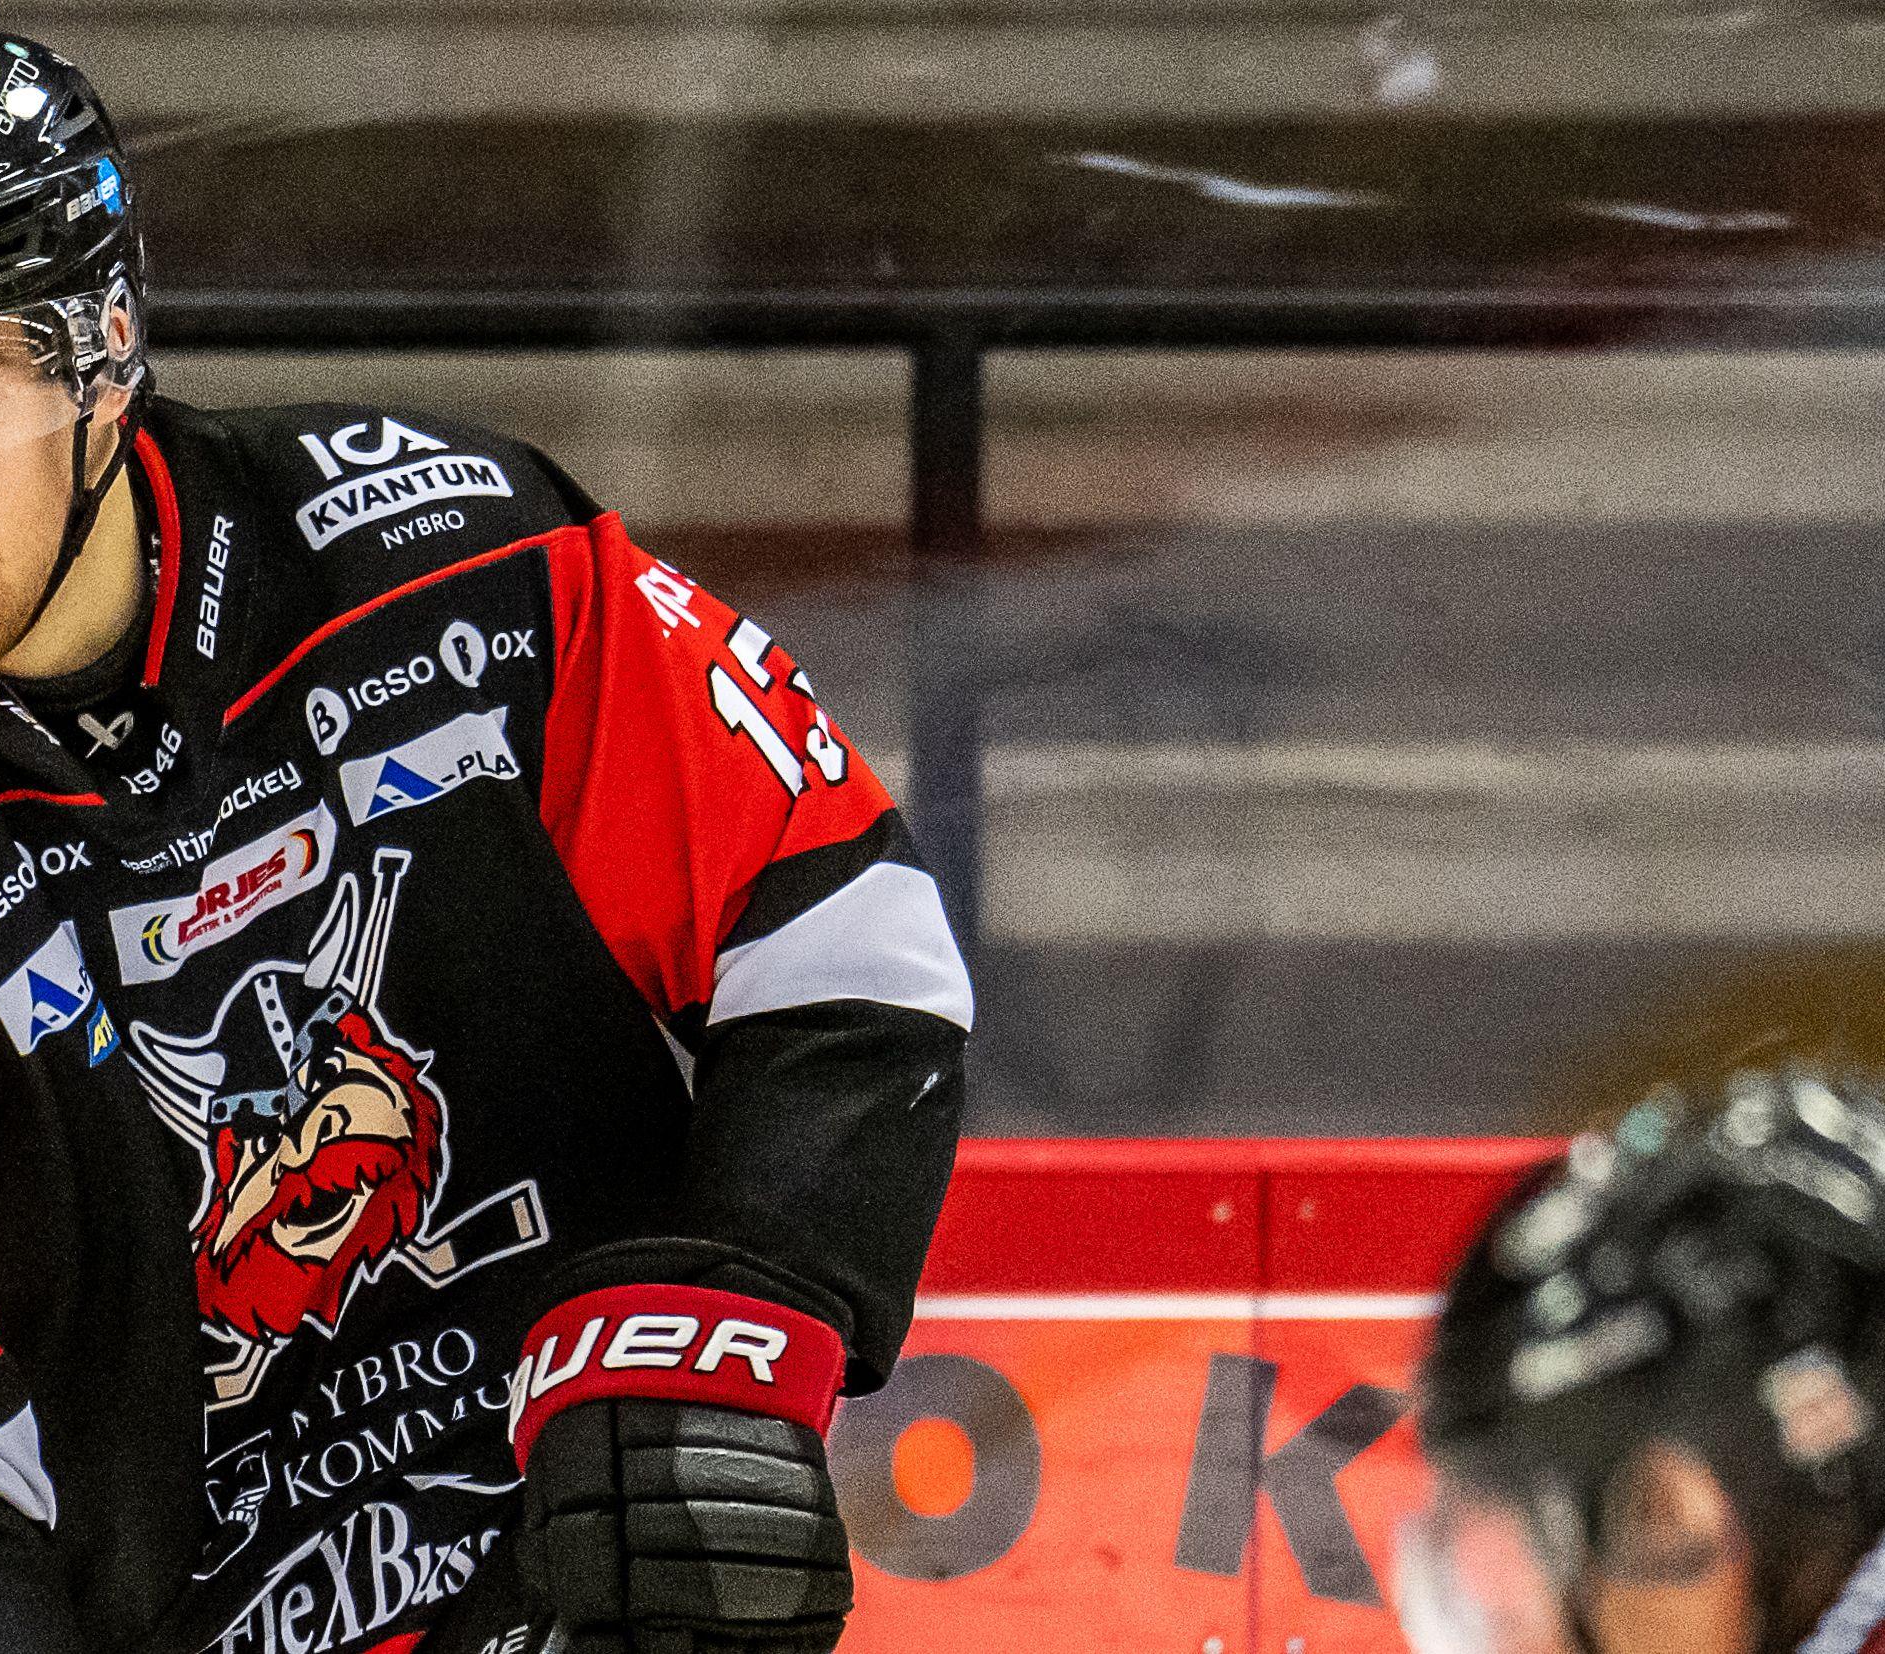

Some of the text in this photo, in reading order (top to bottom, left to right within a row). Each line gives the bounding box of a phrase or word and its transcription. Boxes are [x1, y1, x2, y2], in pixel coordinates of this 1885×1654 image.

[297, 417, 450, 481] ICA
[309, 462, 499, 536] KVANTUM
[380, 510, 465, 550] NYBRO
[120, 722, 183, 795] 1946
